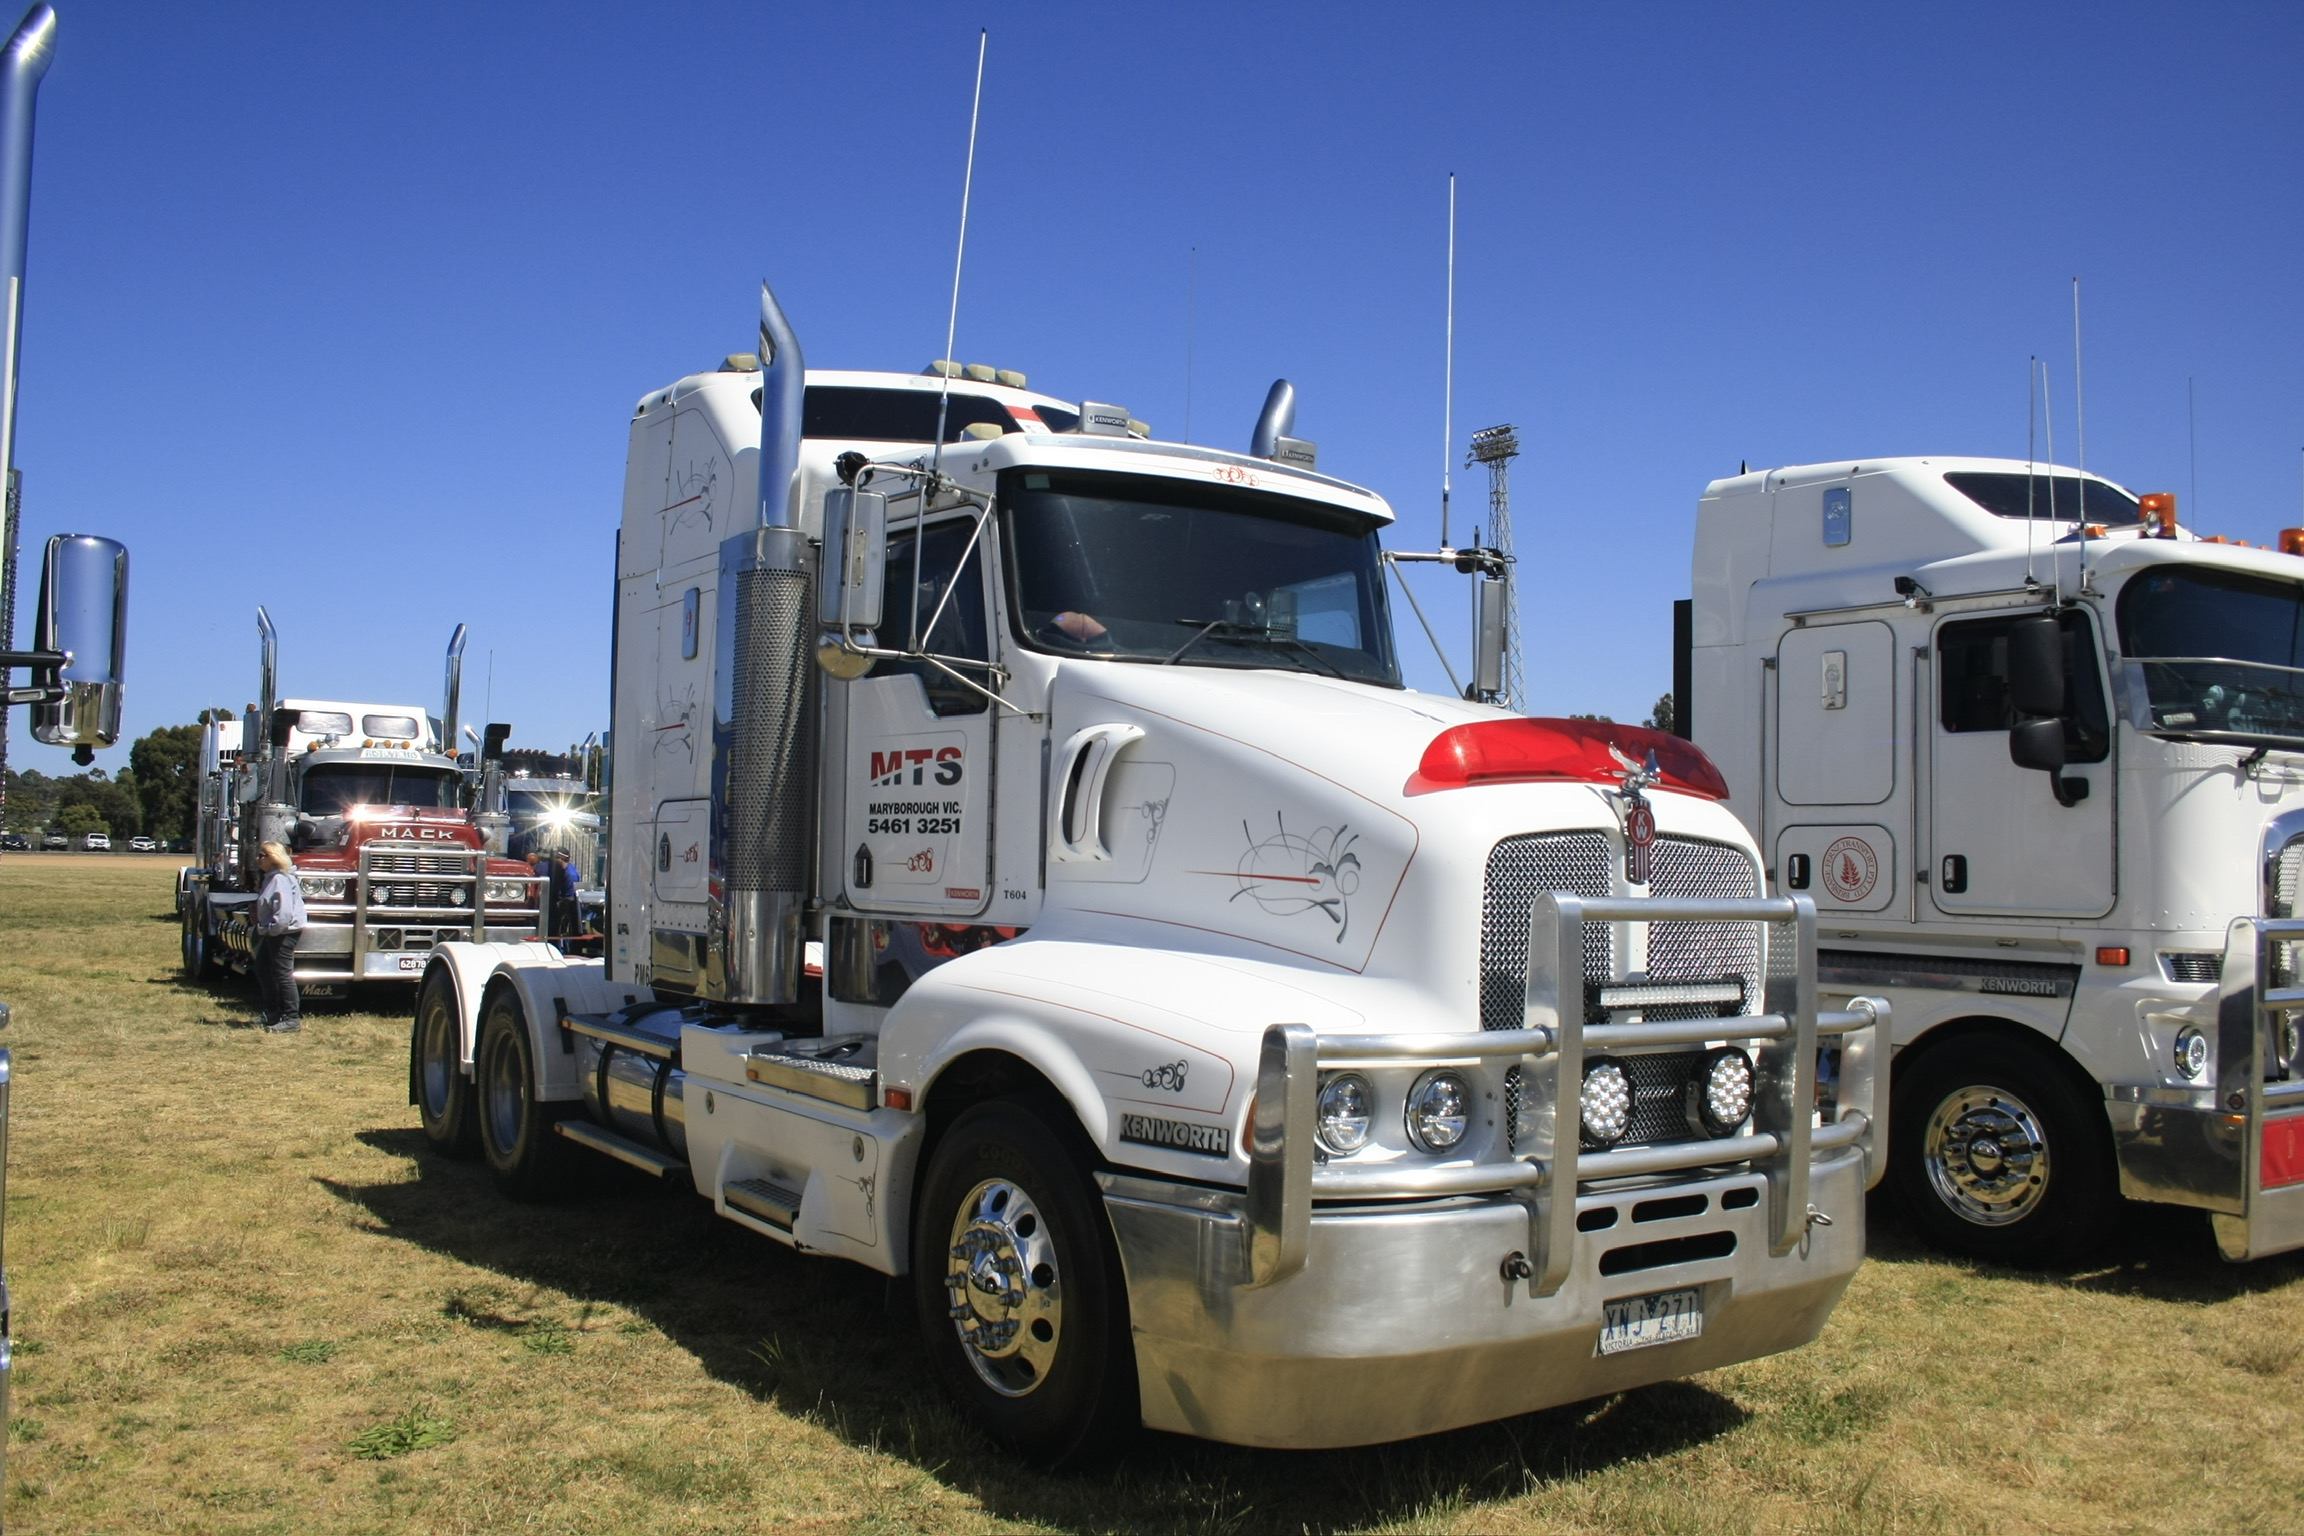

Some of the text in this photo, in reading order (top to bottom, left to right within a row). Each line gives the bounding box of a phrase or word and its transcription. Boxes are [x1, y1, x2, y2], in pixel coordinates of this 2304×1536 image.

[871, 747, 963, 787] MTS
[869, 801, 962, 815] MARYBOROUGH VIC.
[381, 827, 454, 840] MACK
[868, 818, 960, 834] 5461 3251
[1841, 840, 1875, 869] TRANSPORT
[1004, 889, 1027, 900] T604
[400, 960, 429, 969] 62878
[301, 984, 334, 996] Mack
[1981, 977, 2056, 995] KENWORTH
[1121, 1114, 1229, 1153] KENWORTH
[1605, 1296, 1693, 1341] XNJ 271
[1604, 1338, 1633, 1351] VICTORIA
